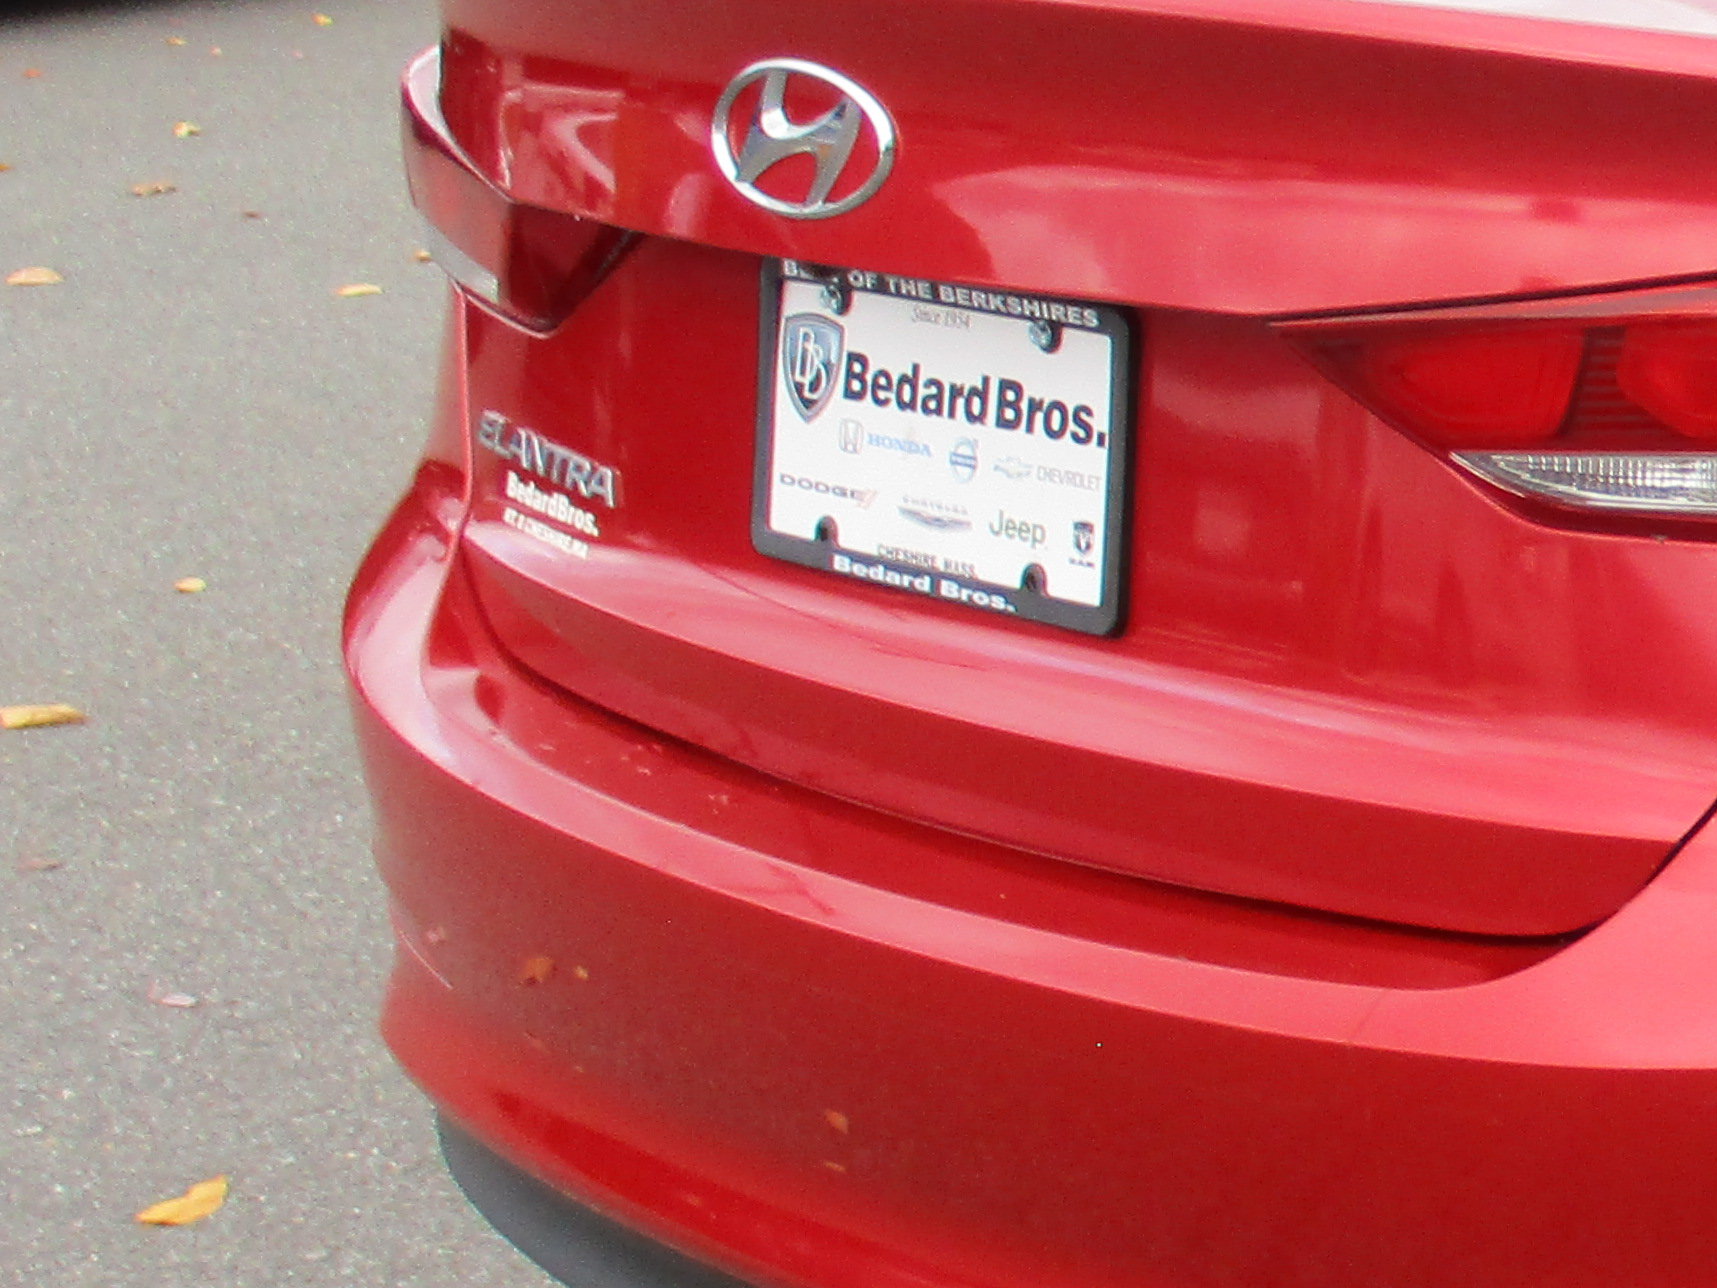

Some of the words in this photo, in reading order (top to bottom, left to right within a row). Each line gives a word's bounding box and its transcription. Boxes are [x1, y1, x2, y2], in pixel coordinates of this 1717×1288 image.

[848, 269, 878, 289] OF
[885, 276, 933, 299] THE
[939, 285, 1100, 327] BERKSHIRES
[843, 351, 991, 425] Bedard
[995, 377, 1106, 448] Bros.
[479, 409, 620, 509] ELANTRA
[867, 432, 932, 458] HONDA
[1037, 465, 1102, 491] CHEVROLET
[989, 509, 1046, 550] Jeep
[832, 553, 932, 593] Bedard
[940, 579, 1017, 612] Bros.
